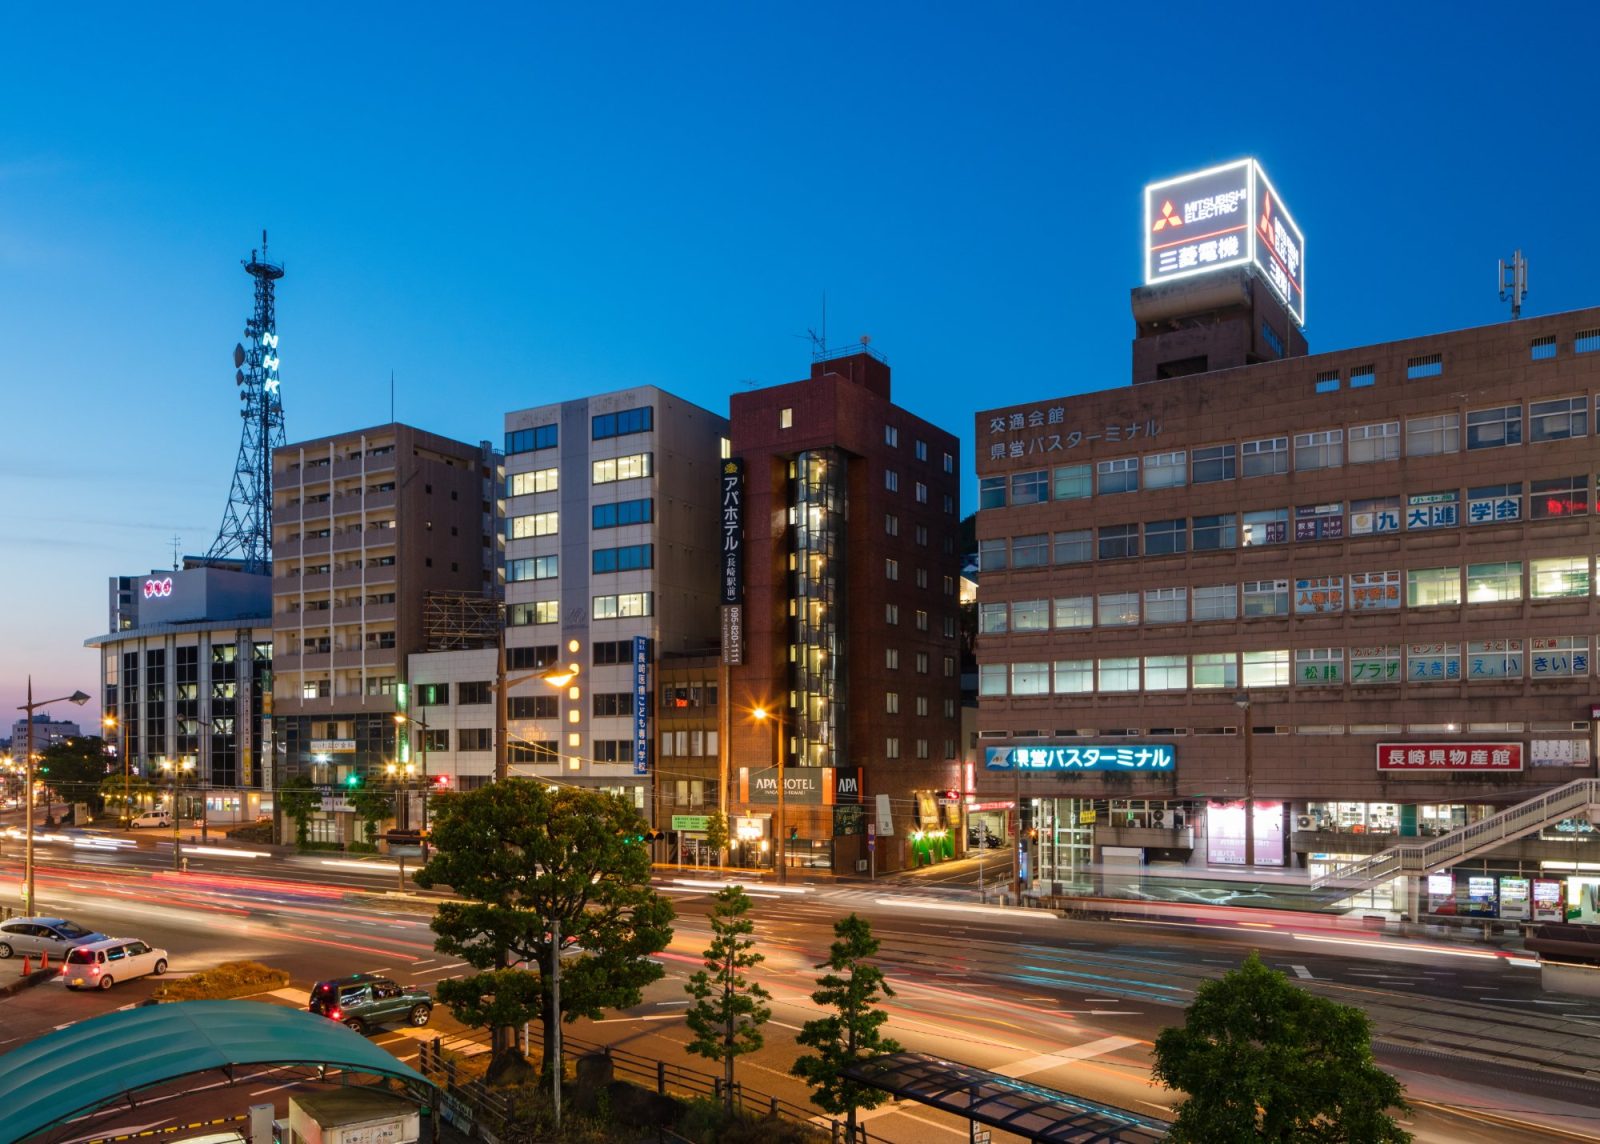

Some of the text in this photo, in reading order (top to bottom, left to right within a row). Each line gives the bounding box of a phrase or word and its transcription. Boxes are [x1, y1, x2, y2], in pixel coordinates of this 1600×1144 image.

[1184, 188, 1247, 214] MITSUBISHI
[1184, 202, 1238, 224] ELECTRIC
[1158, 235, 1239, 272] 三菱電機
[989, 406, 1065, 434] 交通会館
[990, 420, 1164, 461] 県営バスターミナル
[723, 476, 739, 551] アパホテル
[730, 607, 739, 662] 095-820-1111
[1013, 748, 1171, 768] 県営バスターミナル
[1388, 749, 1511, 766] 長崎県物産館
[755, 778, 777, 789] APA
[838, 777, 858, 793] APA
